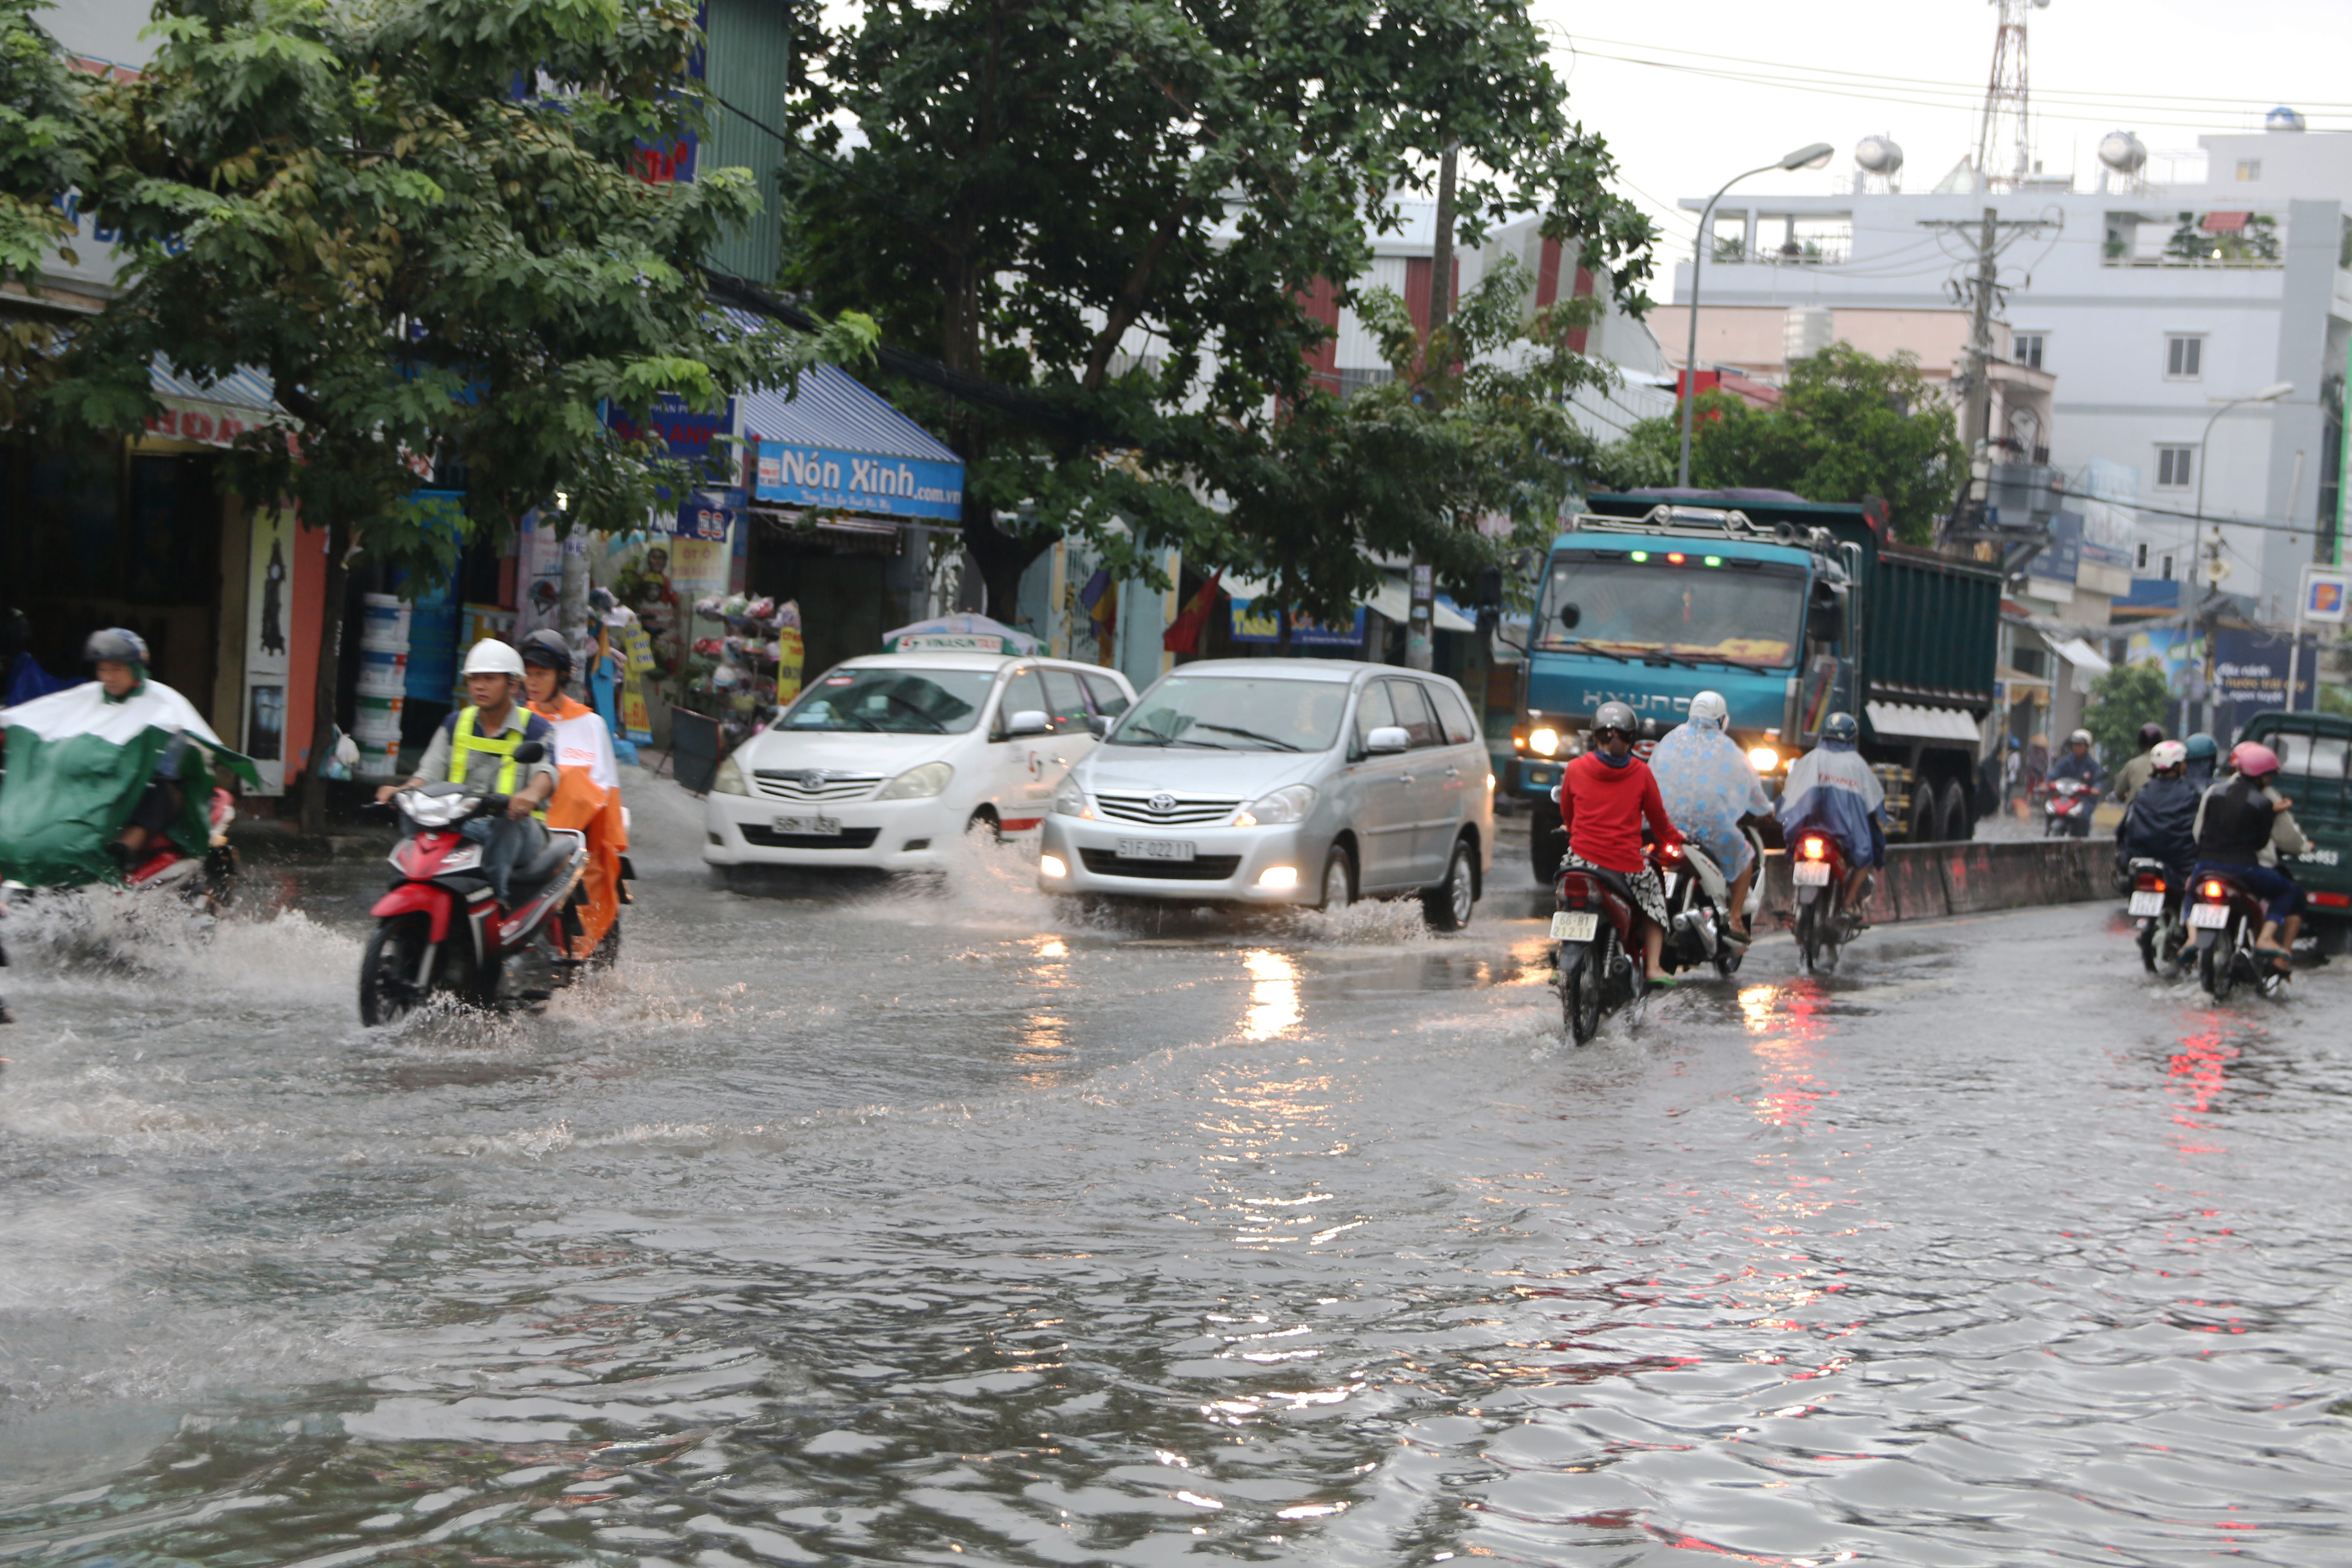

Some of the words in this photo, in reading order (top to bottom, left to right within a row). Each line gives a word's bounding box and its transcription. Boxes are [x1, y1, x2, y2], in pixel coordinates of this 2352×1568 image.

[669, 424, 718, 444] ANH
[781, 449, 841, 491] Nón
[1560, 916, 1589, 926] 66-B1
[1553, 926, 1591, 938] 212.11
